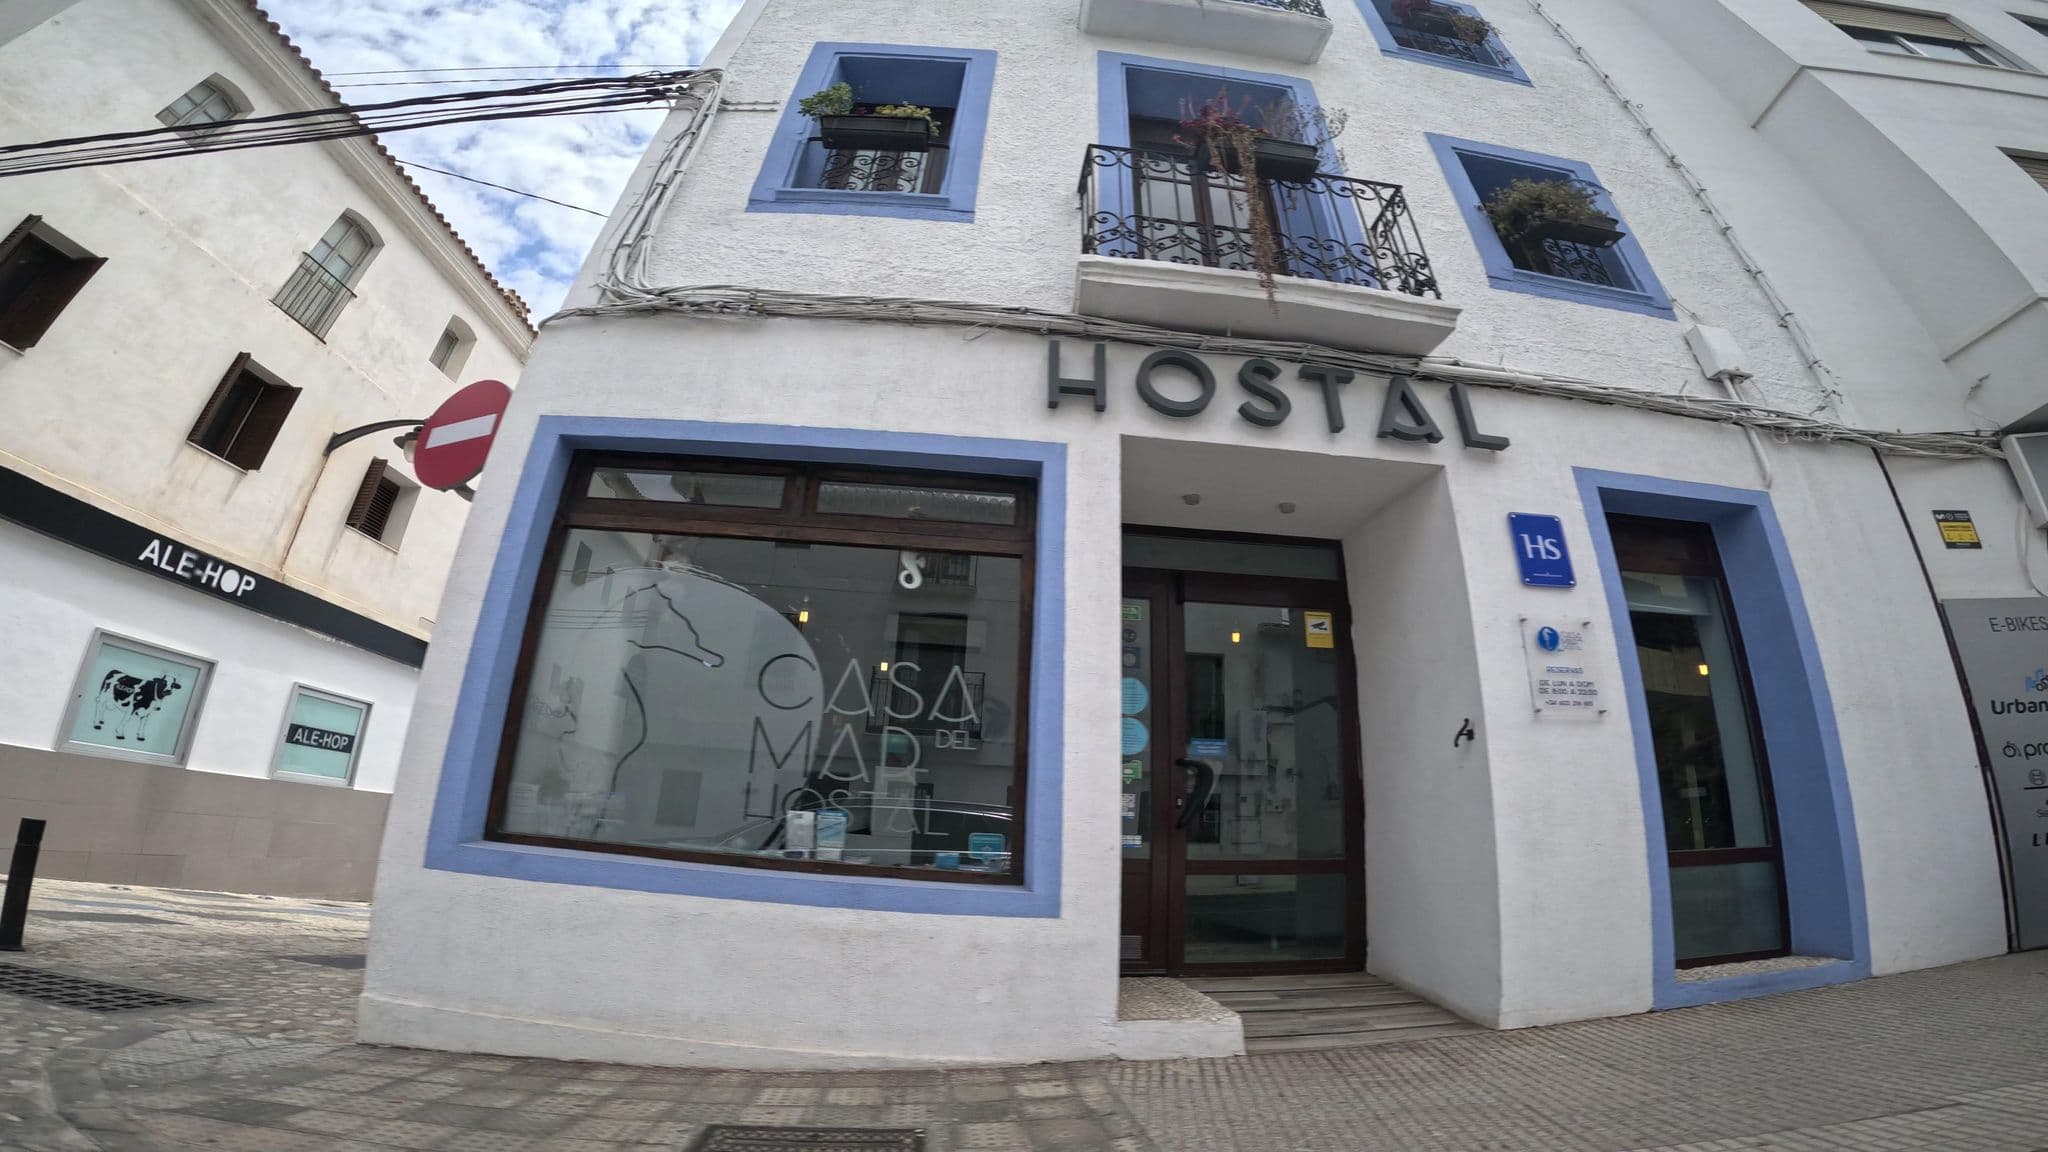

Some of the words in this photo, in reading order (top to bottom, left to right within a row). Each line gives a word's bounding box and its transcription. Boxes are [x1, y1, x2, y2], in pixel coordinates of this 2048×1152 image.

[1048, 340, 1510, 451] HOSTAL
[138, 539, 256, 597] ALE-HOP
[1988, 616, 2048, 632] E-BIKES
[758, 653, 980, 724] CASA
[1990, 698, 2048, 715] Urban
[293, 728, 349, 750] ALE-HOP
[748, 716, 922, 786] MAR
[935, 729, 976, 751] DEL
